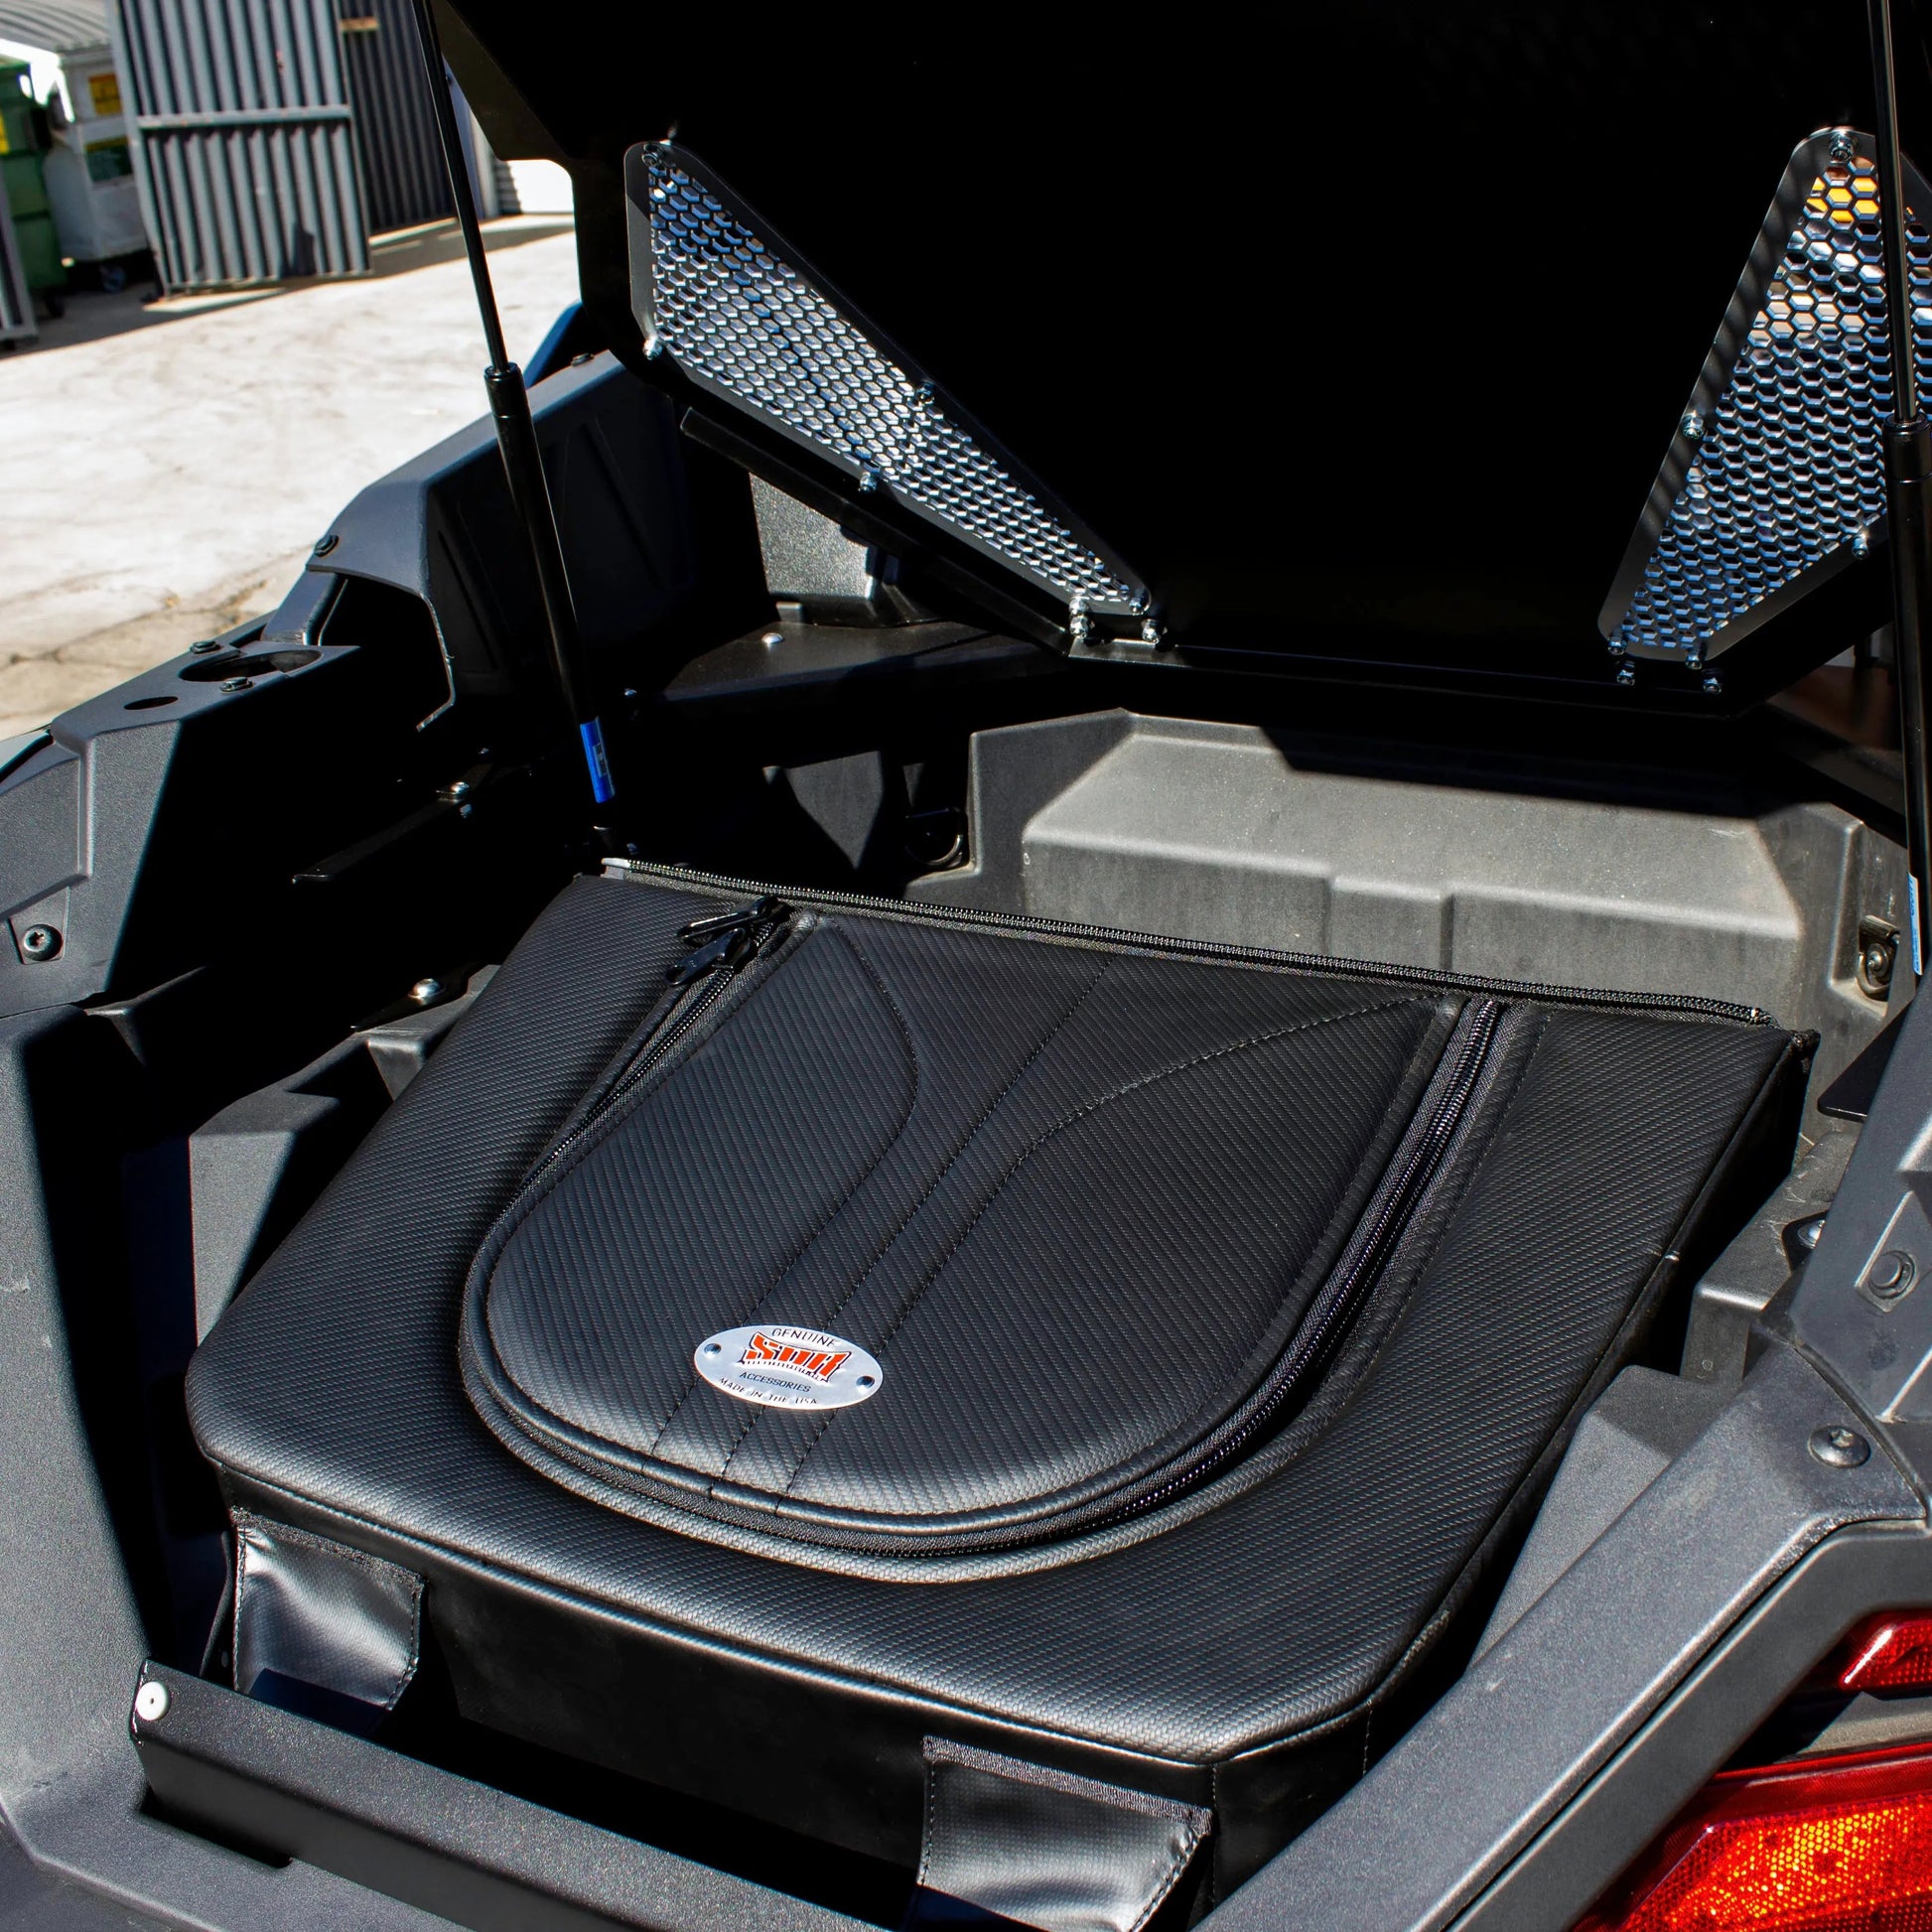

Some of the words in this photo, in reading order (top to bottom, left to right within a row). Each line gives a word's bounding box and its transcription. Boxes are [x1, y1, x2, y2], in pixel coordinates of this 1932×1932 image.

[771, 1327, 838, 1347] GENUINE
[719, 1377, 746, 1393] MADE
[750, 1390, 763, 1399] IN
[768, 1393, 788, 1403] THE
[739, 1371, 812, 1393] ACCESSORIES
